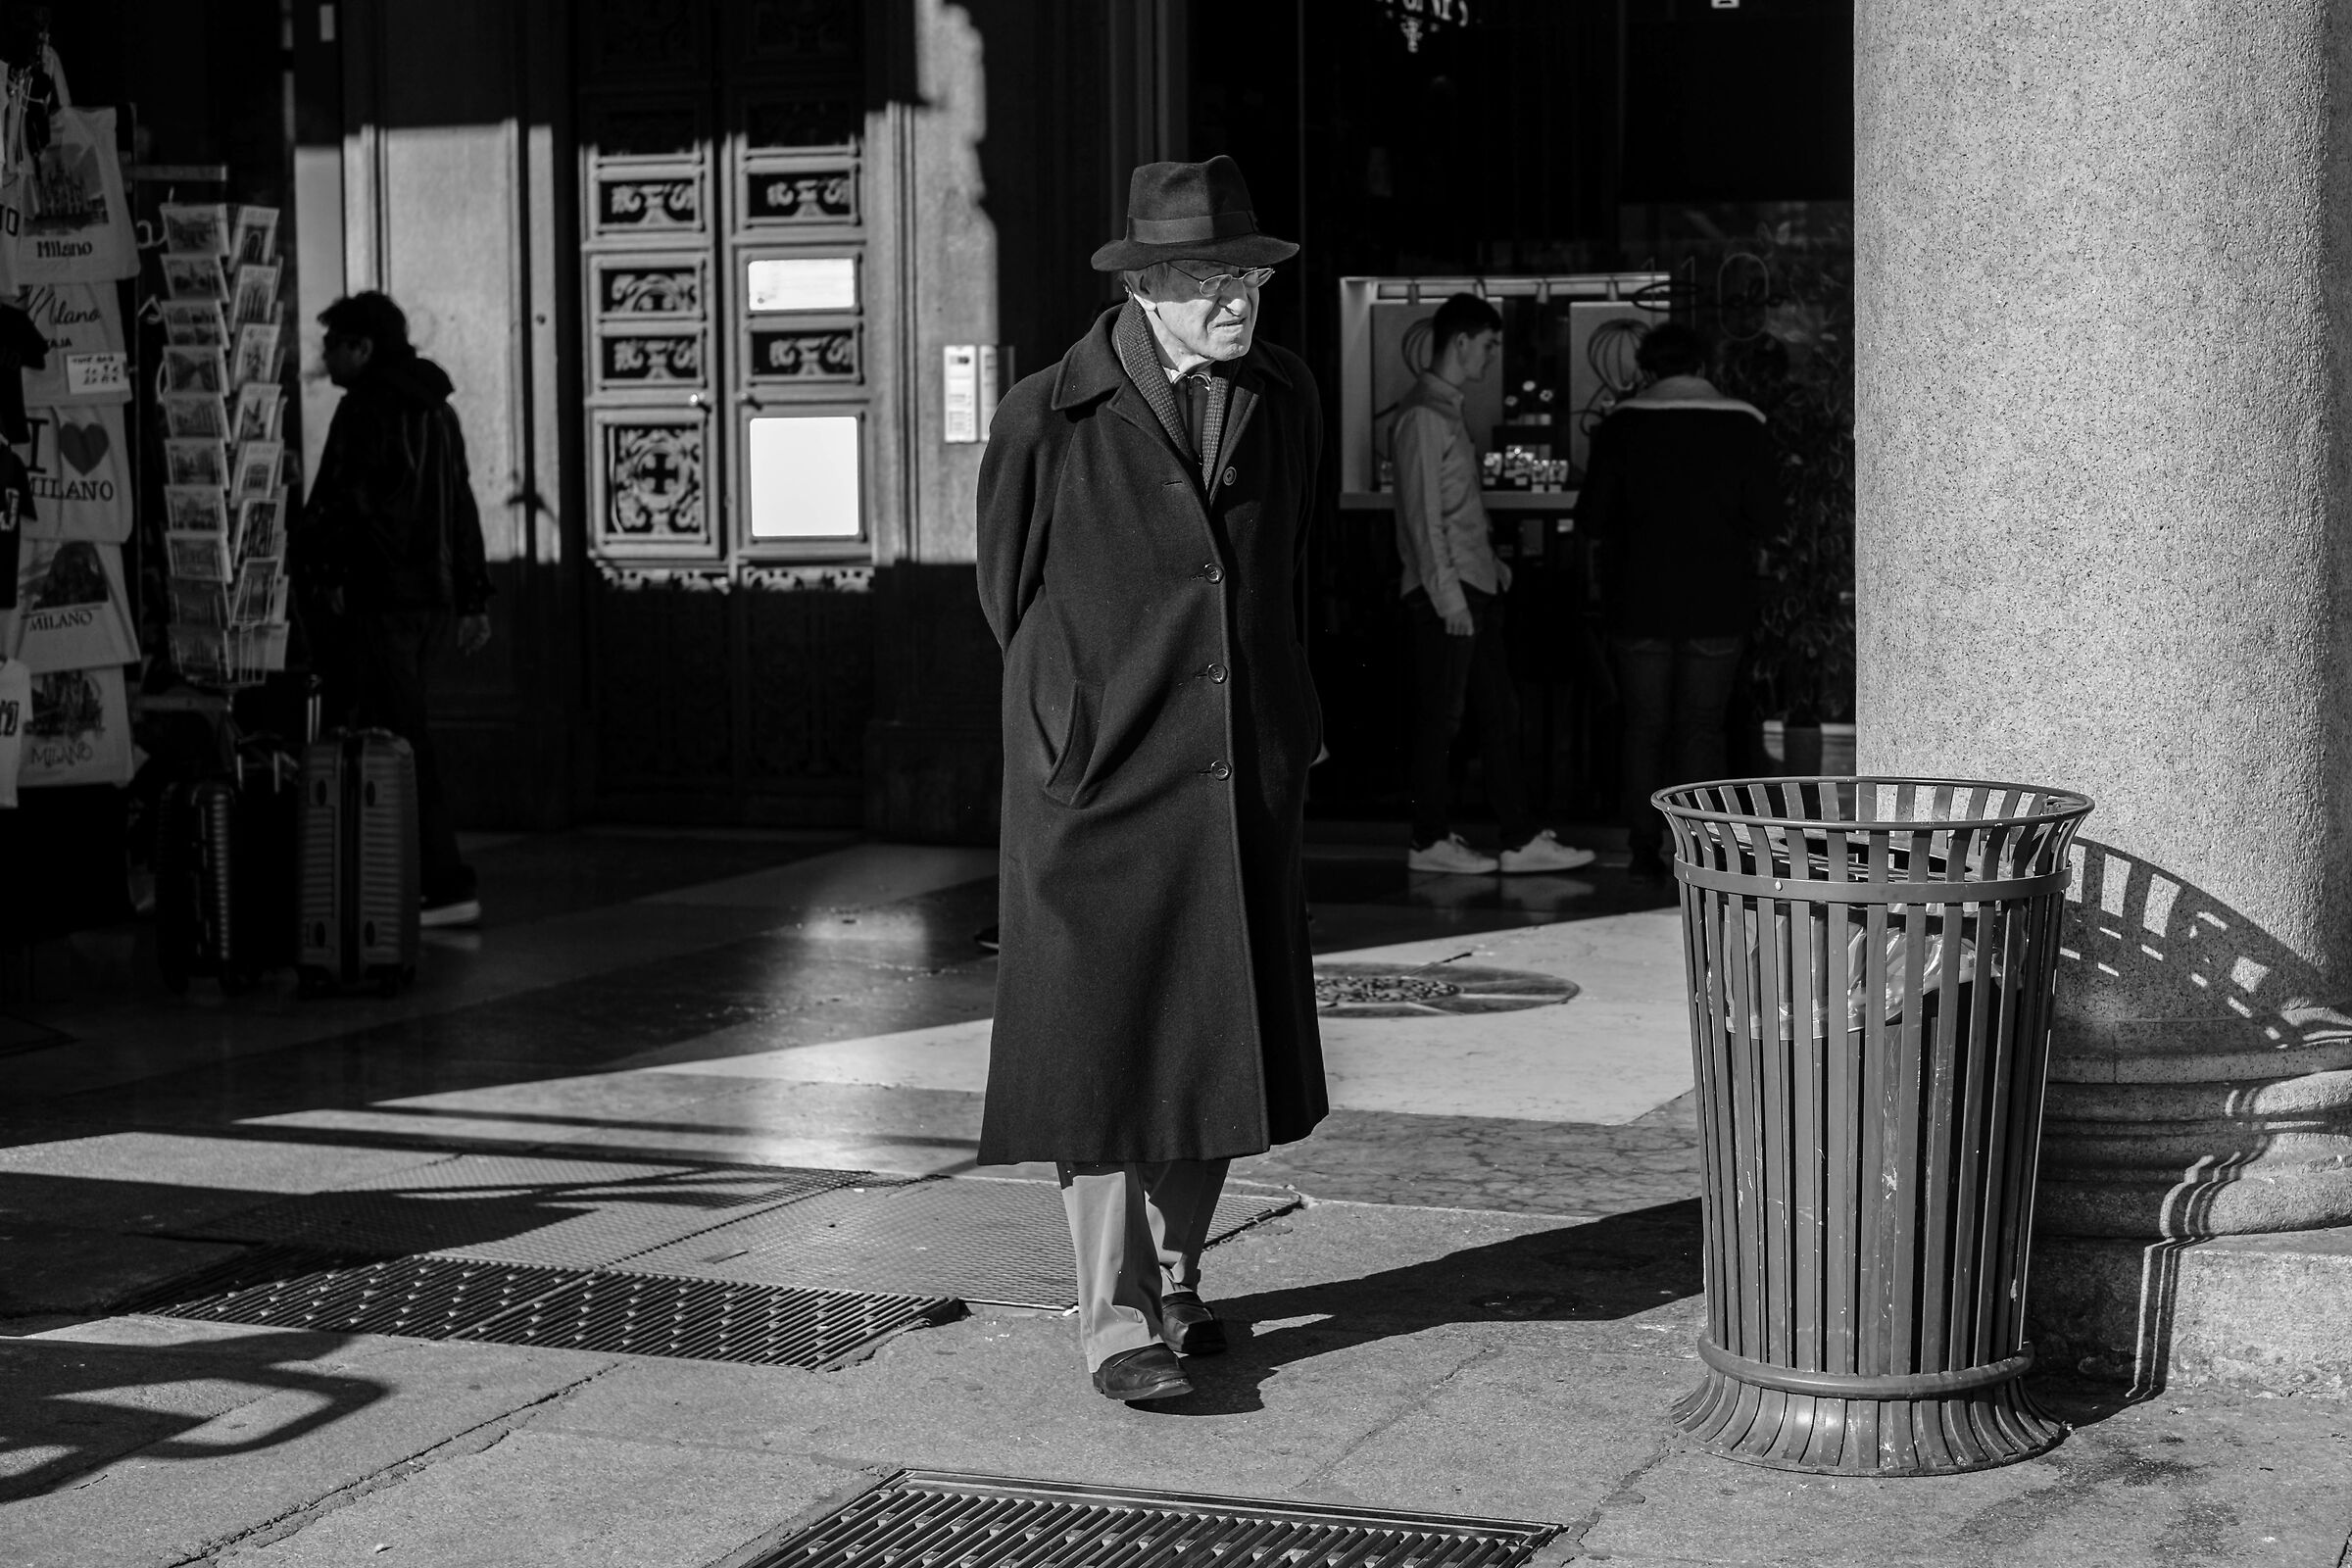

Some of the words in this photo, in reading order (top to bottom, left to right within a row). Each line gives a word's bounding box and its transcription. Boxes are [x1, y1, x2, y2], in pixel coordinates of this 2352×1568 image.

[36, 240, 93, 259] Milano
[25, 417, 50, 474] I
[29, 610, 93, 632] MILANO
[30, 741, 93, 768] MILANO
